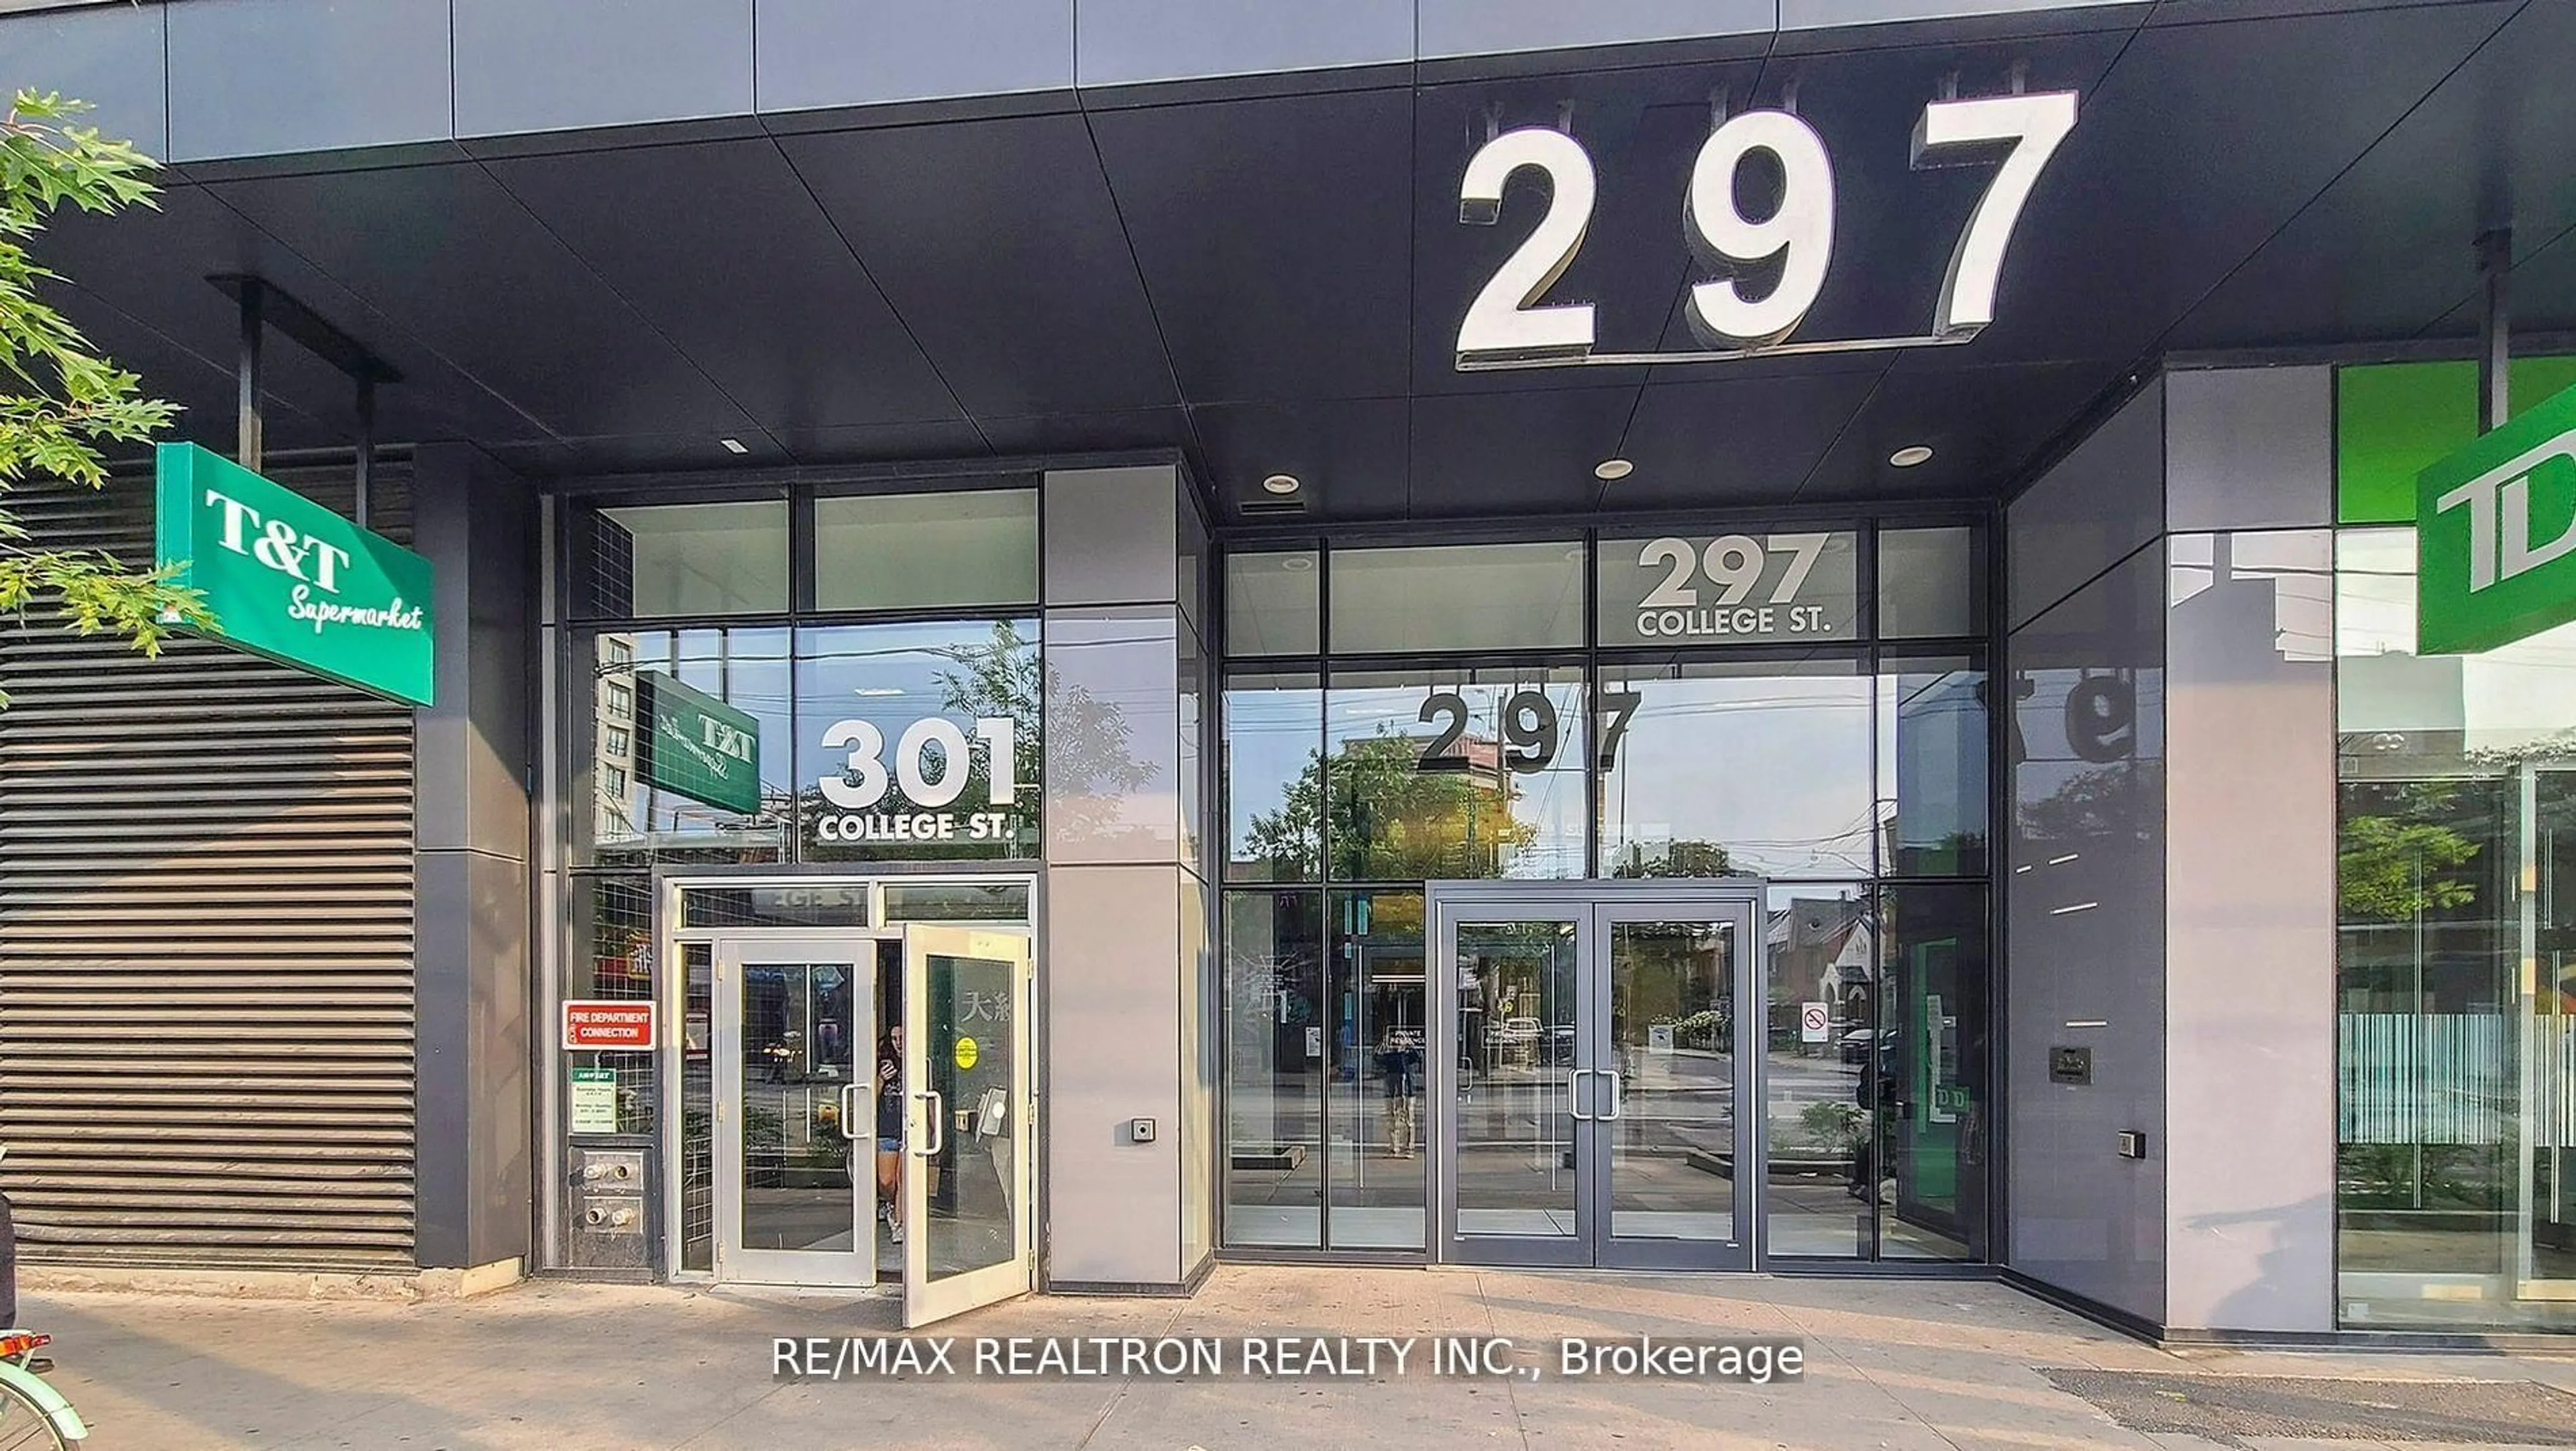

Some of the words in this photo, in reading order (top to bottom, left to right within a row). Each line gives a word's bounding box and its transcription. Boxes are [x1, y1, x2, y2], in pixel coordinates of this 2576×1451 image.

[1456, 90, 2078, 352] 297
[205, 489, 350, 594] T&T
[2436, 428, 2576, 594] TD
[1638, 533, 1831, 607] 297
[287, 584, 423, 634] Supermarket
[1636, 608, 1774, 637] COLLEGE
[1789, 605, 1831, 633] ST.
[819, 716, 1015, 809] 301
[818, 813, 954, 841] COLLEGE
[969, 812, 1015, 840] ST.
[570, 1012, 589, 1023] FIRE
[590, 1012, 649, 1024] DEPARTMENT
[580, 1027, 639, 1038] CONNECTION
